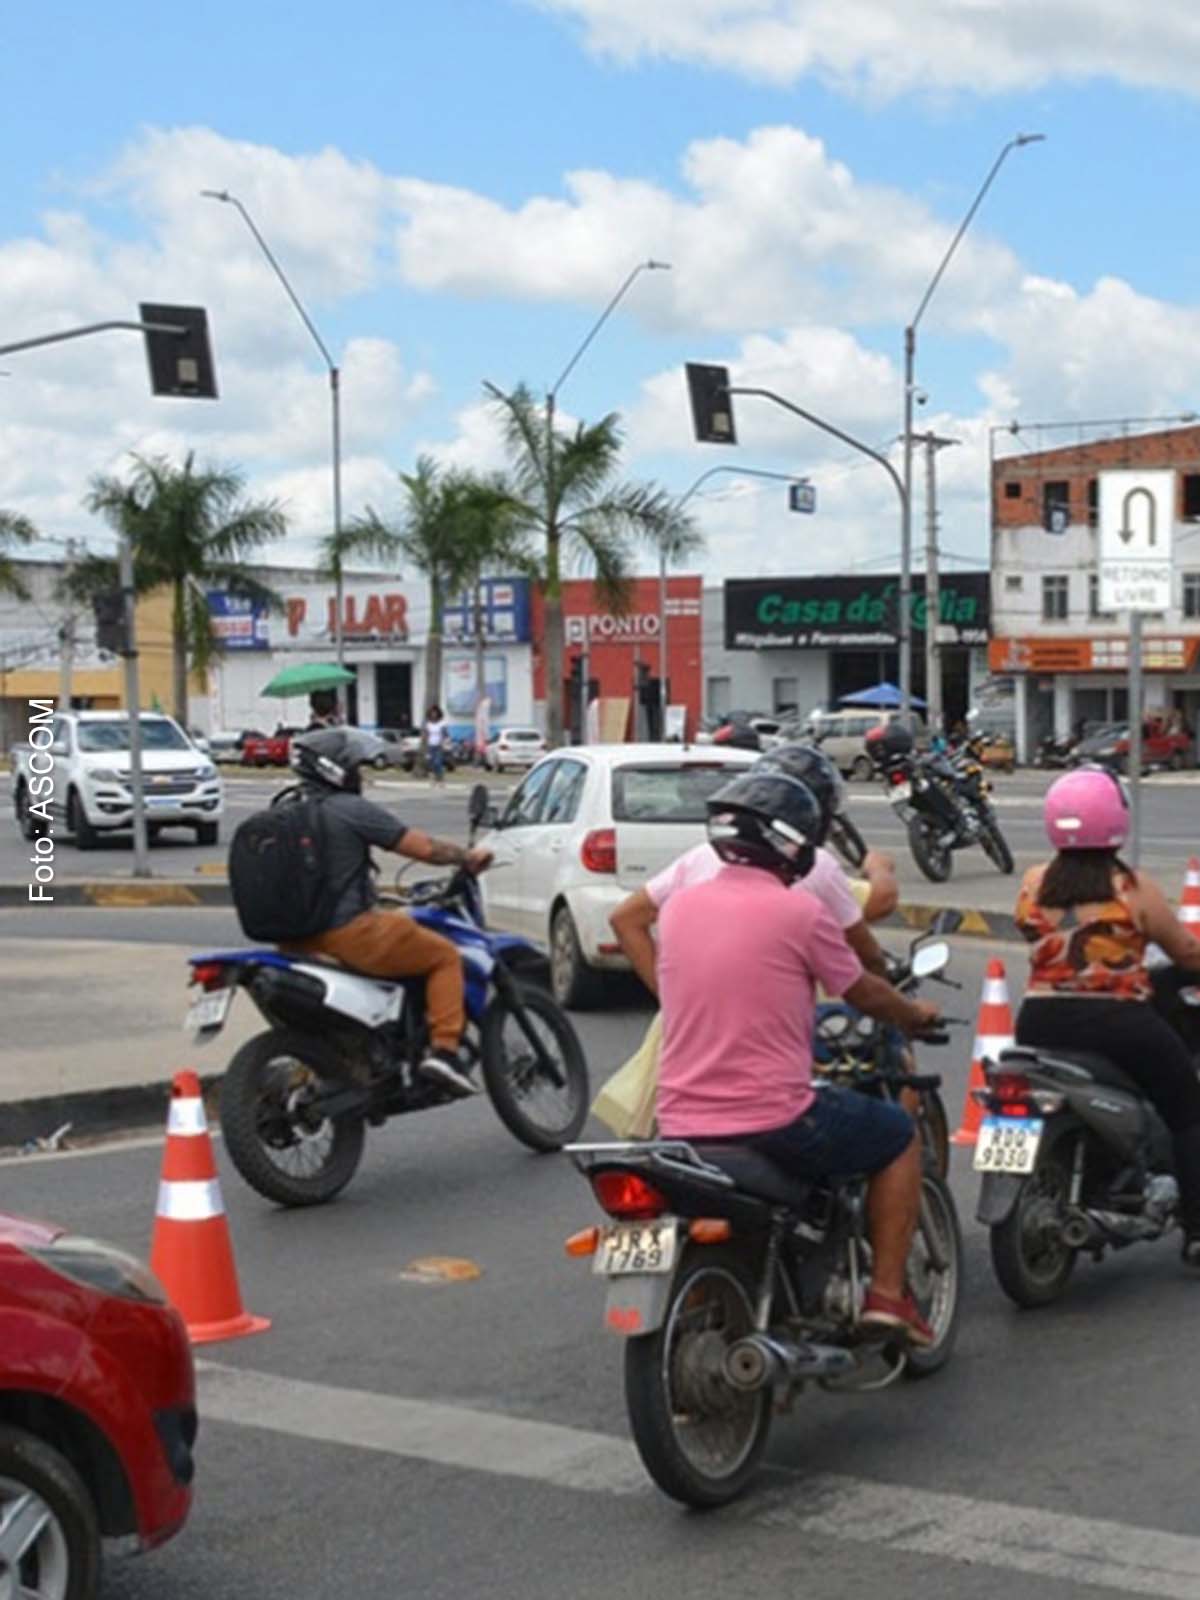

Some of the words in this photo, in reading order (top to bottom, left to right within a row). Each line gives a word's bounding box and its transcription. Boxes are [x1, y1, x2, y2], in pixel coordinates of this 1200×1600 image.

[1114, 587, 1156, 603] LIVRE
[757, 592, 840, 624] Casa
[588, 614, 660, 635] PONTO
